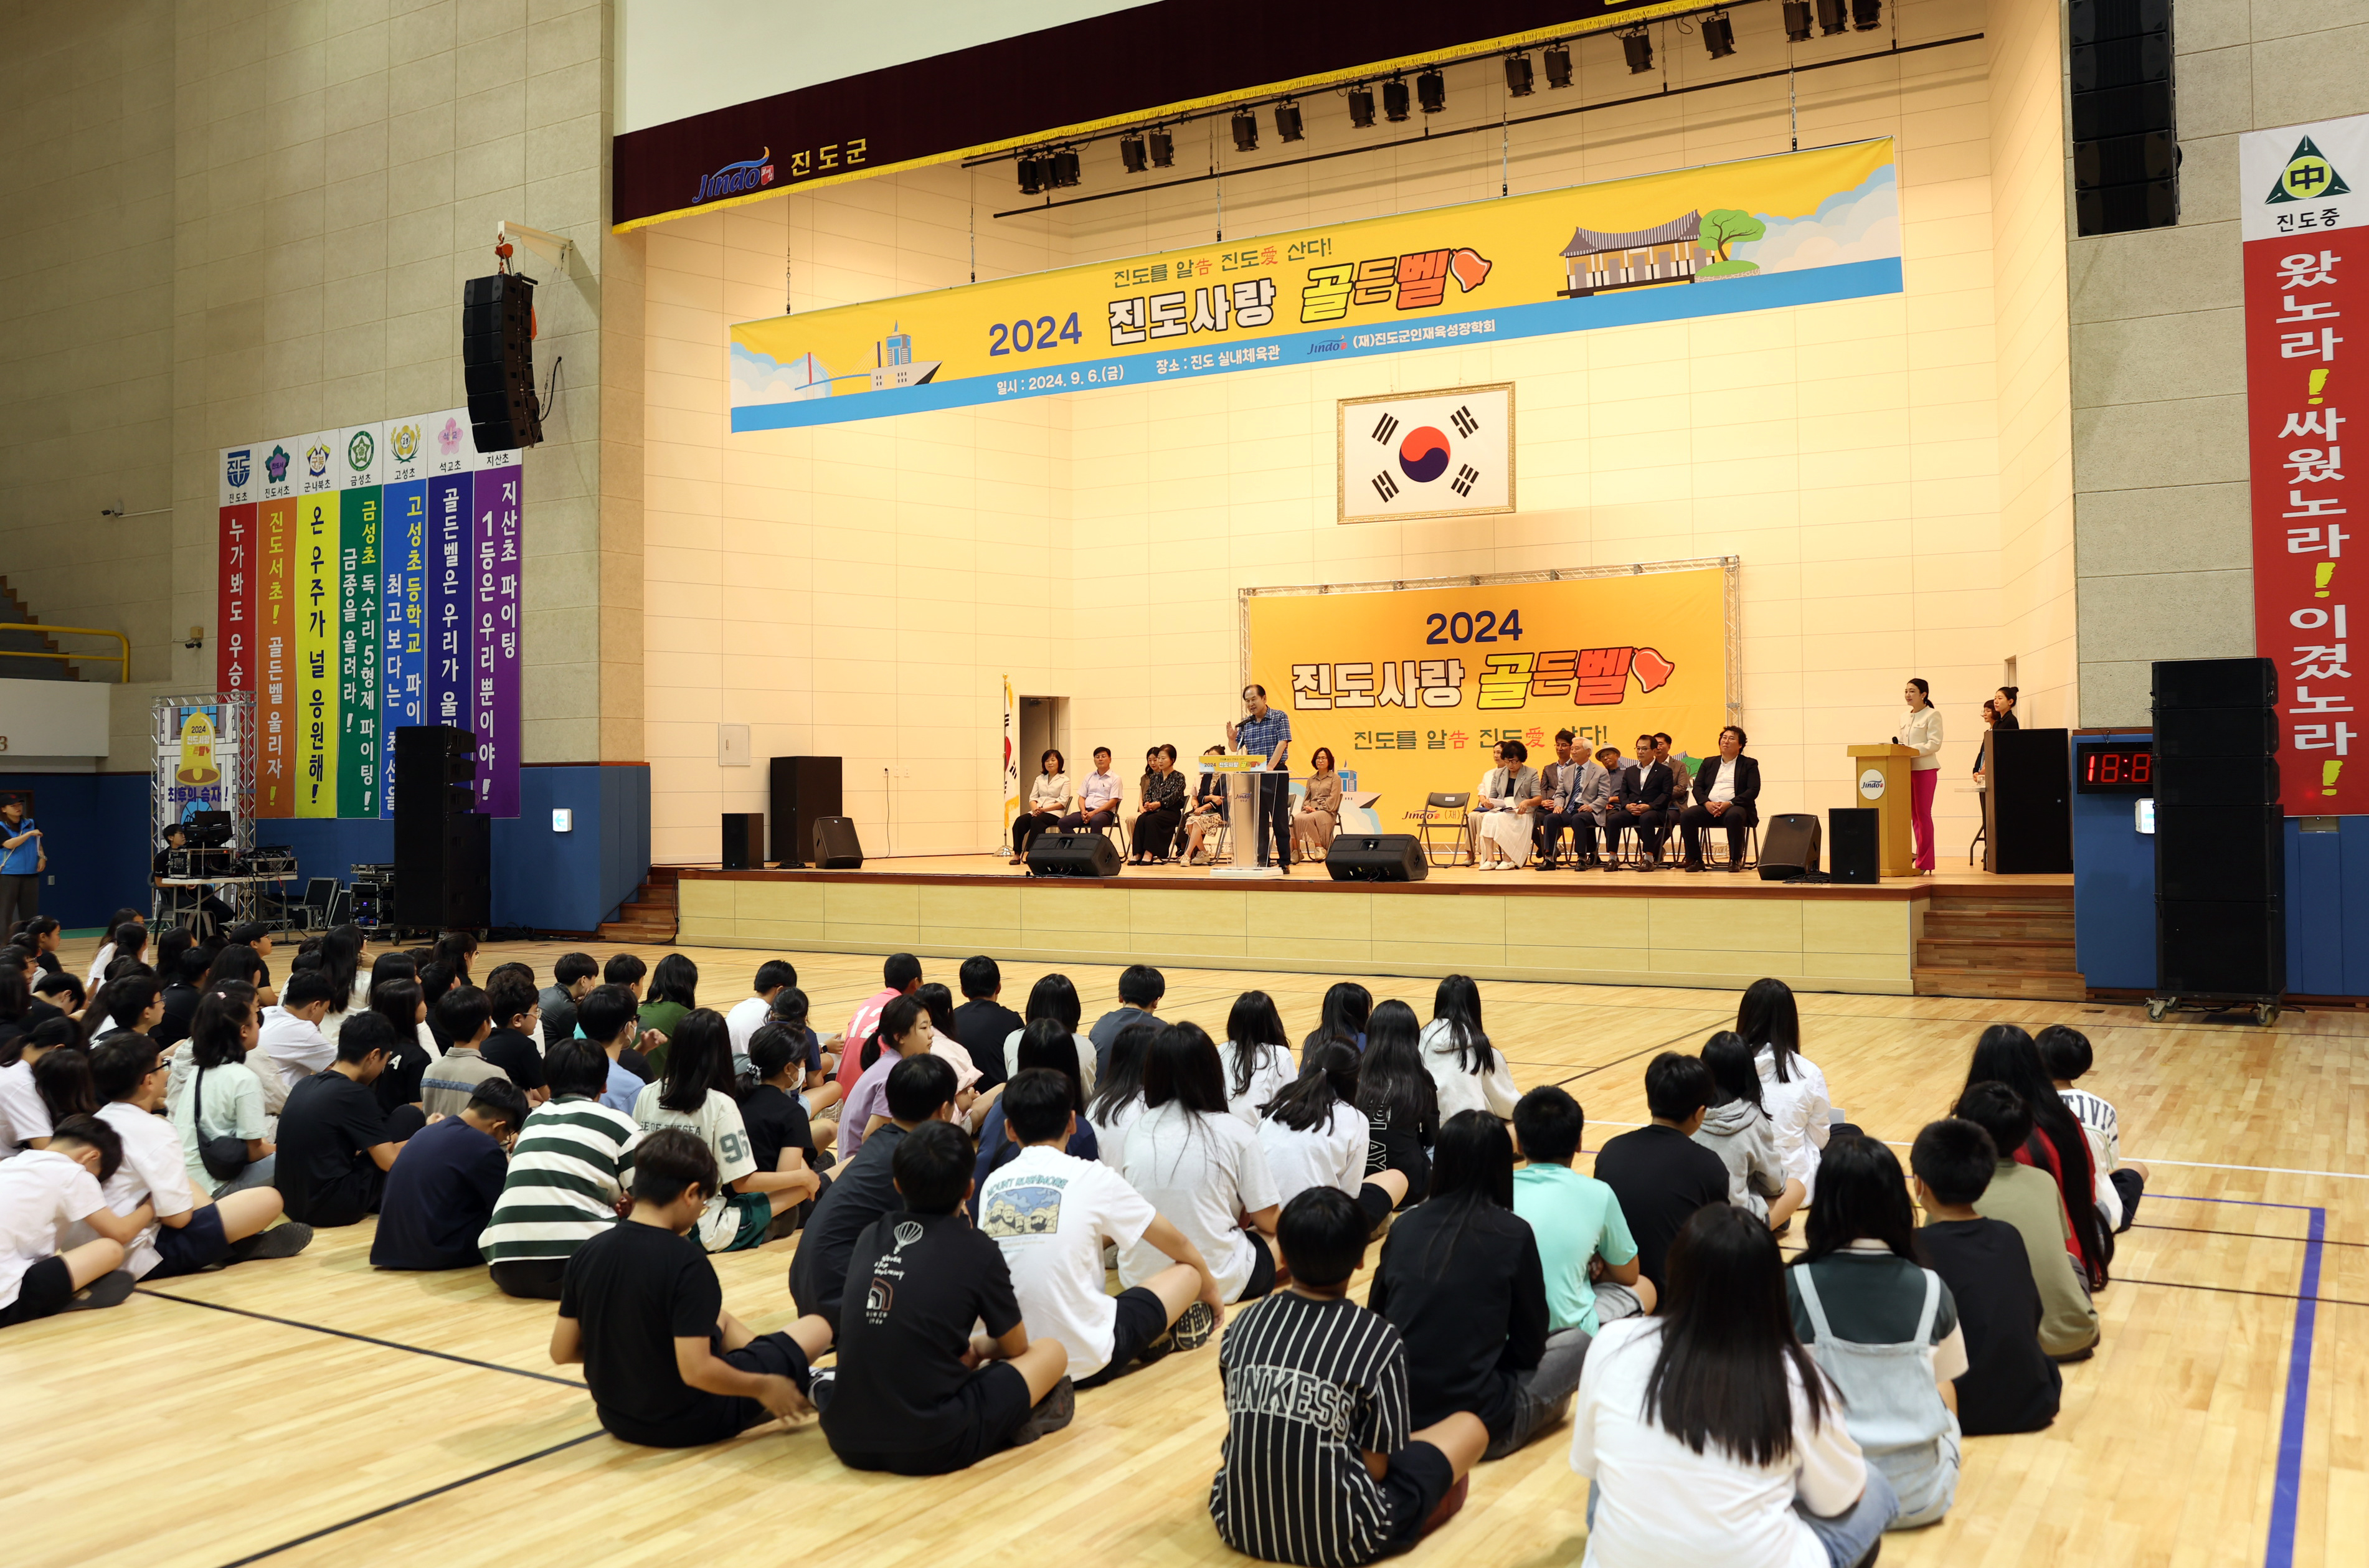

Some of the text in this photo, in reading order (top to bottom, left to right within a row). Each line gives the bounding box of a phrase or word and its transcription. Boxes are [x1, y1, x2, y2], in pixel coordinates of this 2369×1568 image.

[790, 138, 867, 177] 진도군
[692, 168, 761, 203] Jindo
[2290, 164, 2325, 189] 中
[2276, 207, 2340, 233] 진도중
[1114, 238, 1332, 288] 진도를 알告 진도愛 산다!
[989, 248, 1451, 357] 2024 진도사랑 골든벨
[1307, 341, 1340, 355] Jindo
[1352, 319, 1496, 349] (재)진도군인재육성장학회
[1156, 358, 1180, 375] 장소
[1190, 354, 1214, 371] 진도
[1218, 344, 1281, 367] 실내체육관
[996, 378, 1018, 395] 일시
[1028, 374, 1067, 390] 2024.
[394, 468, 415, 480] 고성초
[440, 460, 461, 473] 석교초
[486, 453, 509, 466] 지산초
[265, 485, 290, 499] 진도서초
[350, 473, 371, 486] 금성초
[229, 492, 248, 504] 진도초
[310, 506, 324, 535] 온
[362, 501, 377, 564] 금성초
[2276, 250, 2357, 796] 왔노라! 싸웠노라! 이겼노라!
[442, 488, 460, 595] 골든벨은
[479, 511, 496, 602] 1등은
[268, 511, 284, 625] 진도서초!
[343, 548, 357, 623] 금종을
[500, 480, 518, 659] 지산초 파이팅
[310, 545, 326, 638] 우주가
[361, 574, 376, 640] 독수리
[442, 603, 459, 682] 우리가
[1426, 609, 1523, 645] 2024
[268, 636, 283, 704] 골든벨
[310, 650, 324, 679] 널
[1292, 646, 1634, 710] 진도사랑 골든벨
[191, 725, 206, 734] 2024
[1354, 730, 1417, 750] 진도를
[1427, 729, 1469, 750] 알告
[360, 718, 374, 811] 파이팅!
[168, 786, 197, 803] 최후의
